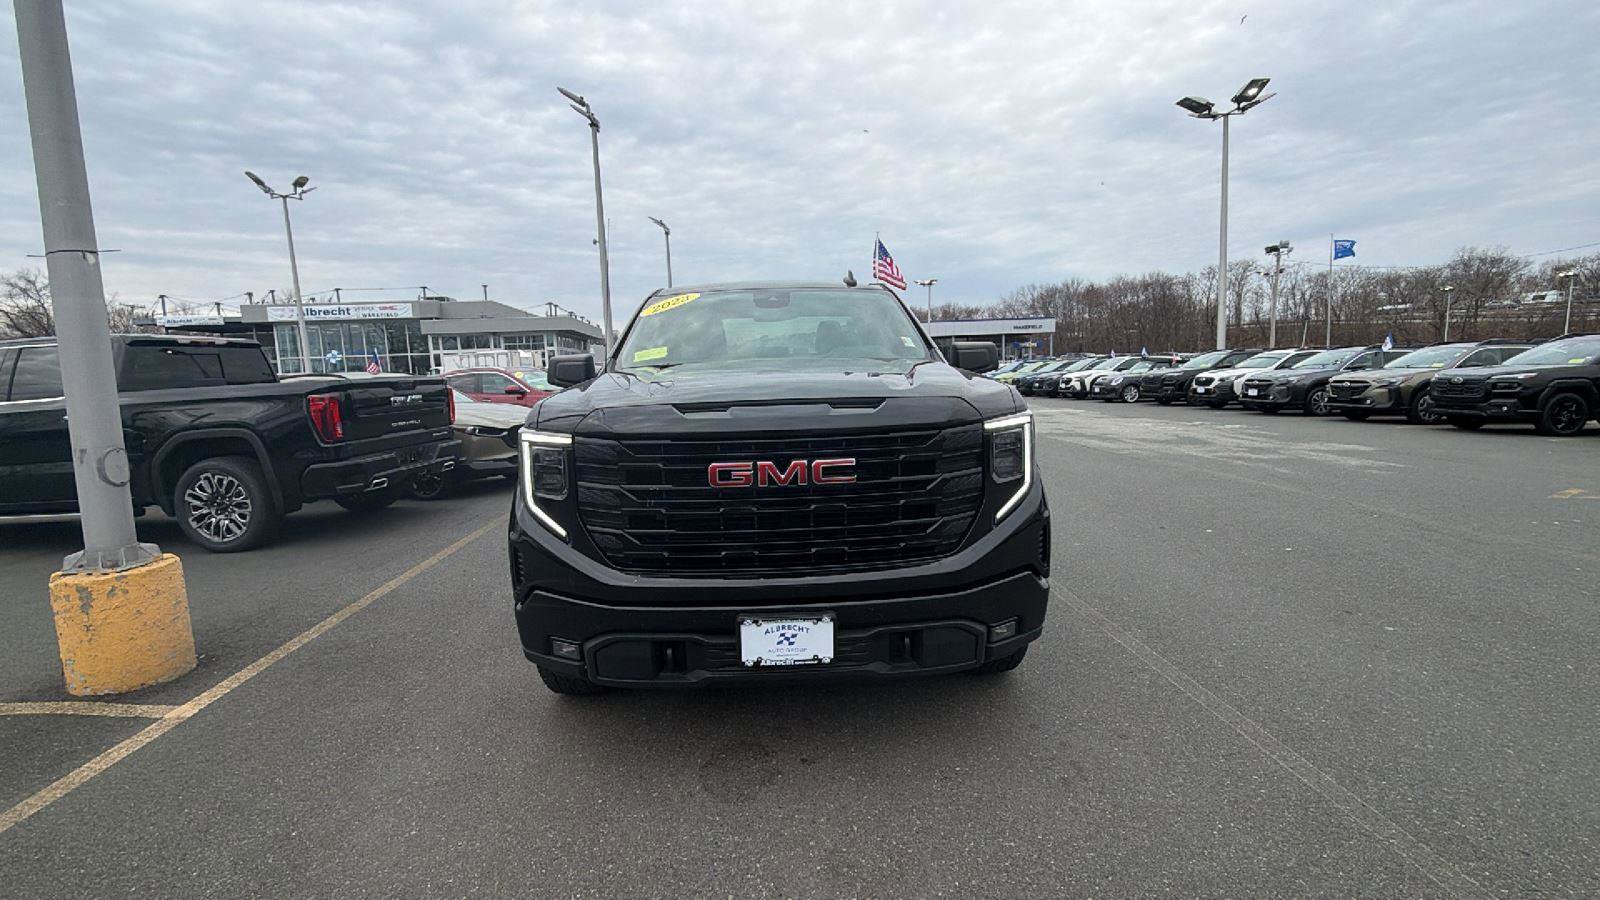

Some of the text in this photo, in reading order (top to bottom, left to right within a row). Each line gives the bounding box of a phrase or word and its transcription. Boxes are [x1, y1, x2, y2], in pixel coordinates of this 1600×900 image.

[302, 307, 351, 316] lbrecht
[708, 458, 857, 488] GMC
[764, 624, 810, 635] ALBRECHT
[760, 658, 795, 666] Albrecht
